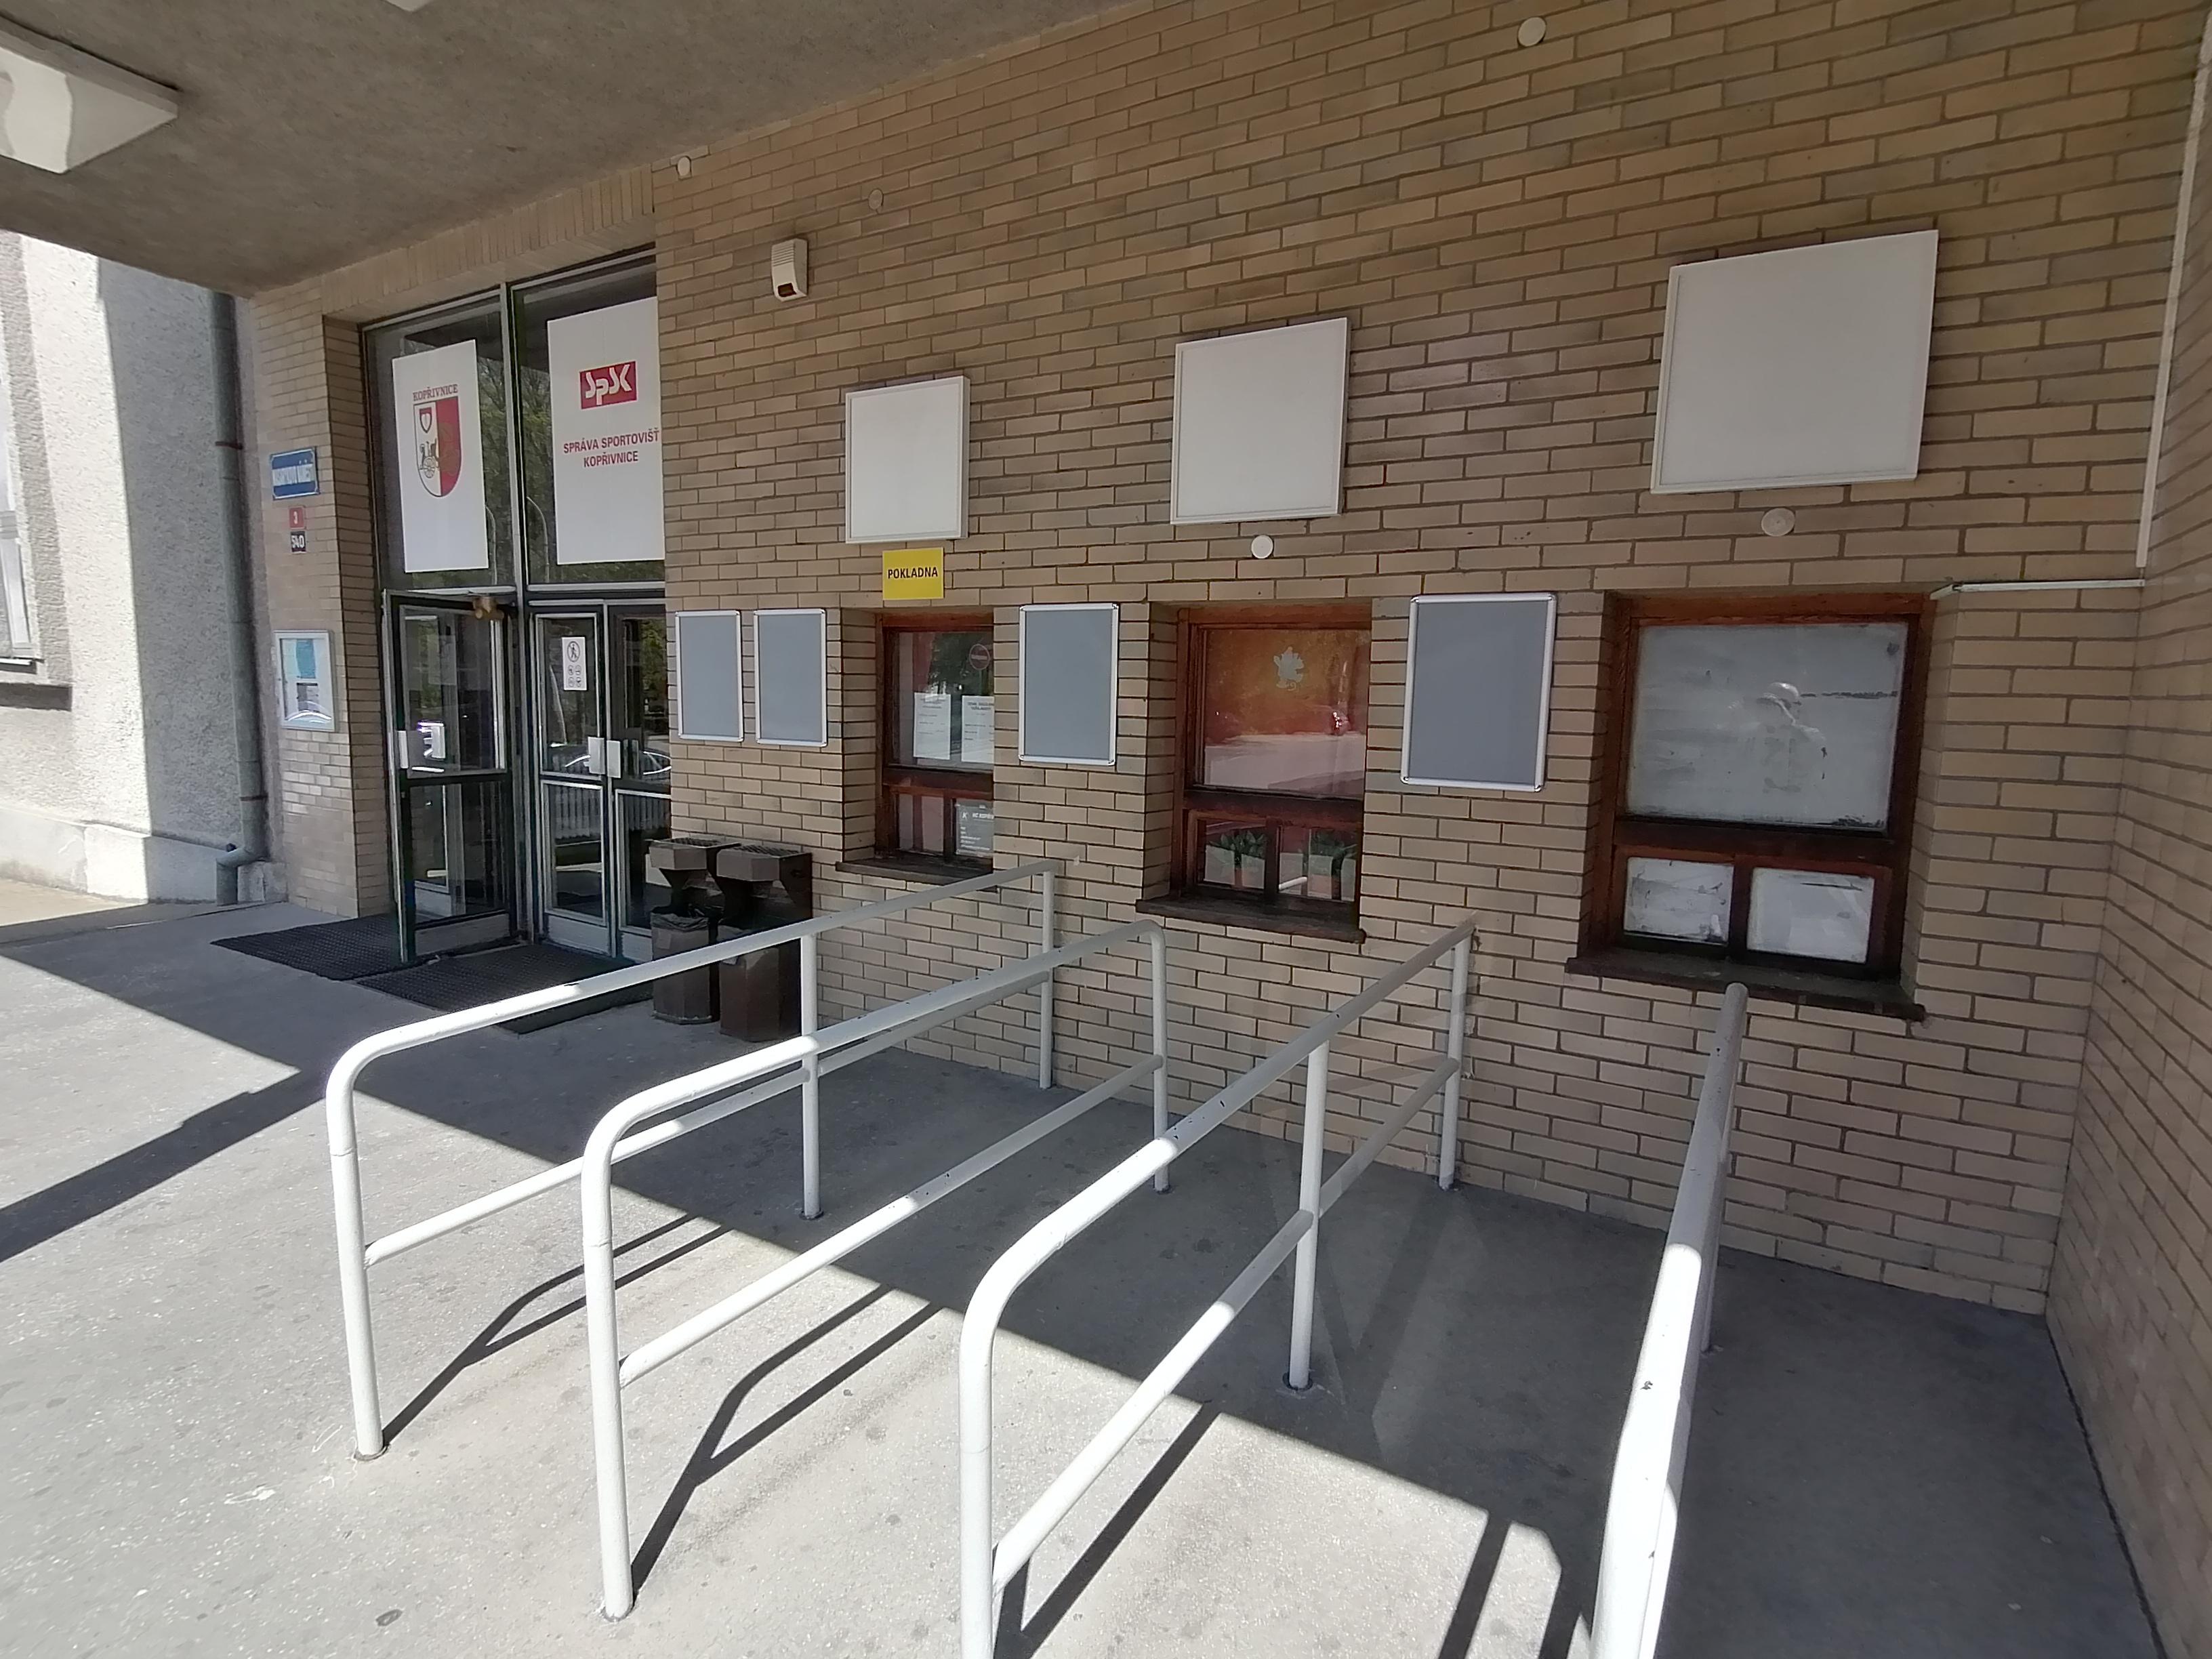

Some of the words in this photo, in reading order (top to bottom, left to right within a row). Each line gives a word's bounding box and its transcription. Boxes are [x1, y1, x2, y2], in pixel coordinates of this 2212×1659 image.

[413, 384, 459, 401] KOPŘIVNICE
[563, 438, 599, 454] SPRÁVA
[601, 428, 659, 449] SPORTOVIŠŤ
[583, 451, 638, 468] KOPŘIVNICE
[888, 567, 938, 579] POKLADNA
